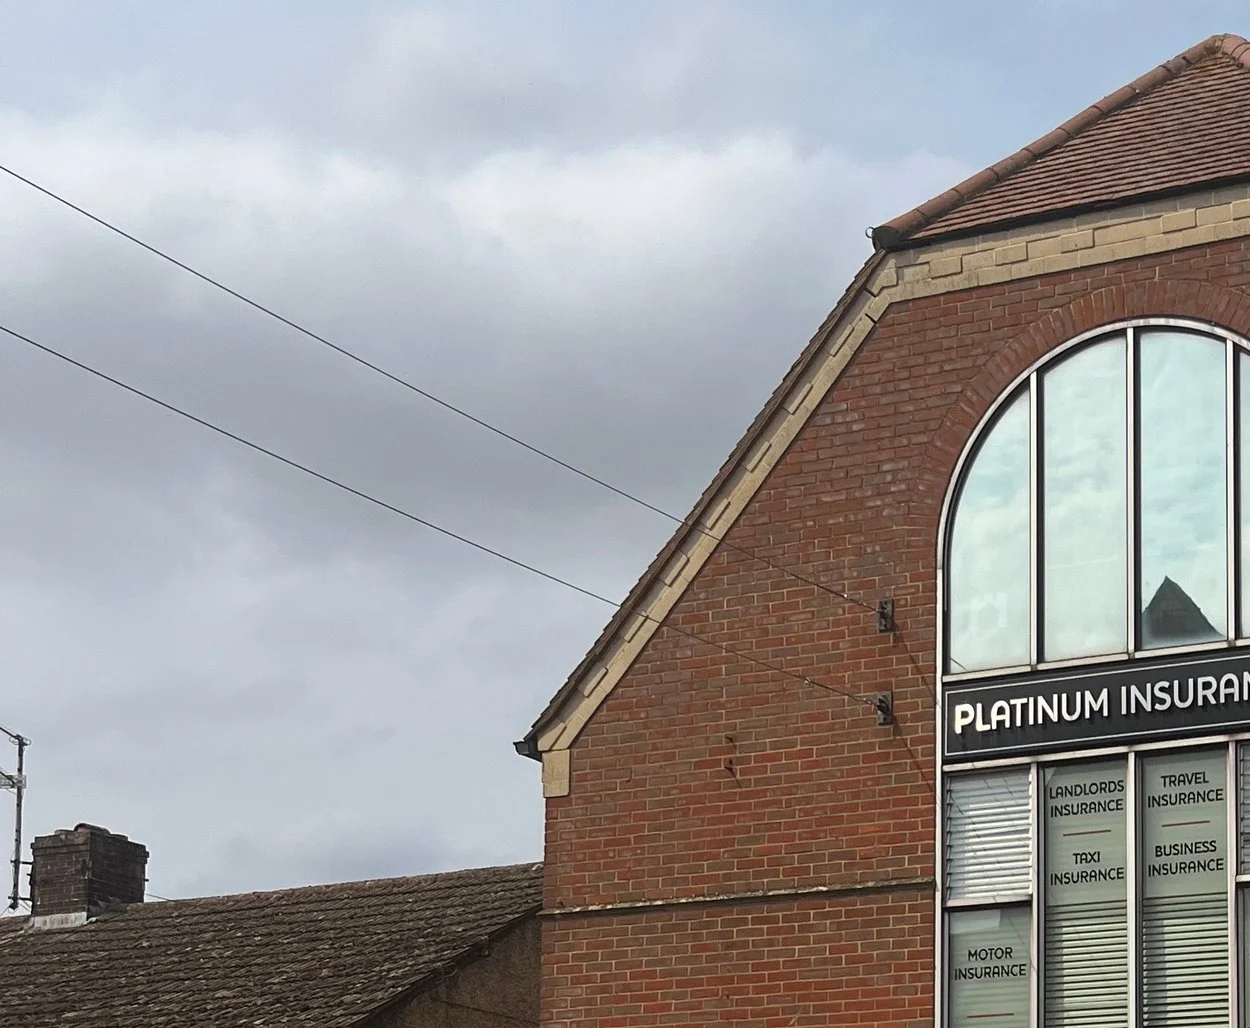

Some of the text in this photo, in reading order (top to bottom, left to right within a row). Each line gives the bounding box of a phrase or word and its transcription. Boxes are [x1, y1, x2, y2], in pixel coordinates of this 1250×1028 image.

[954, 687, 1109, 734] PLATINUM
[1160, 771, 1209, 788] TRAVEL
[1049, 780, 1125, 800] LANDLORDS
[1147, 788, 1224, 809] INSURANCE
[1050, 799, 1124, 818] INSURANCE
[1072, 850, 1101, 865] TAXI
[1154, 840, 1217, 858] BUSINESS
[1050, 867, 1125, 886] INSURANCE
[1147, 858, 1224, 877] INSURANCE
[967, 946, 1013, 962] MOTOR
[954, 963, 1027, 981] INSURANCE
